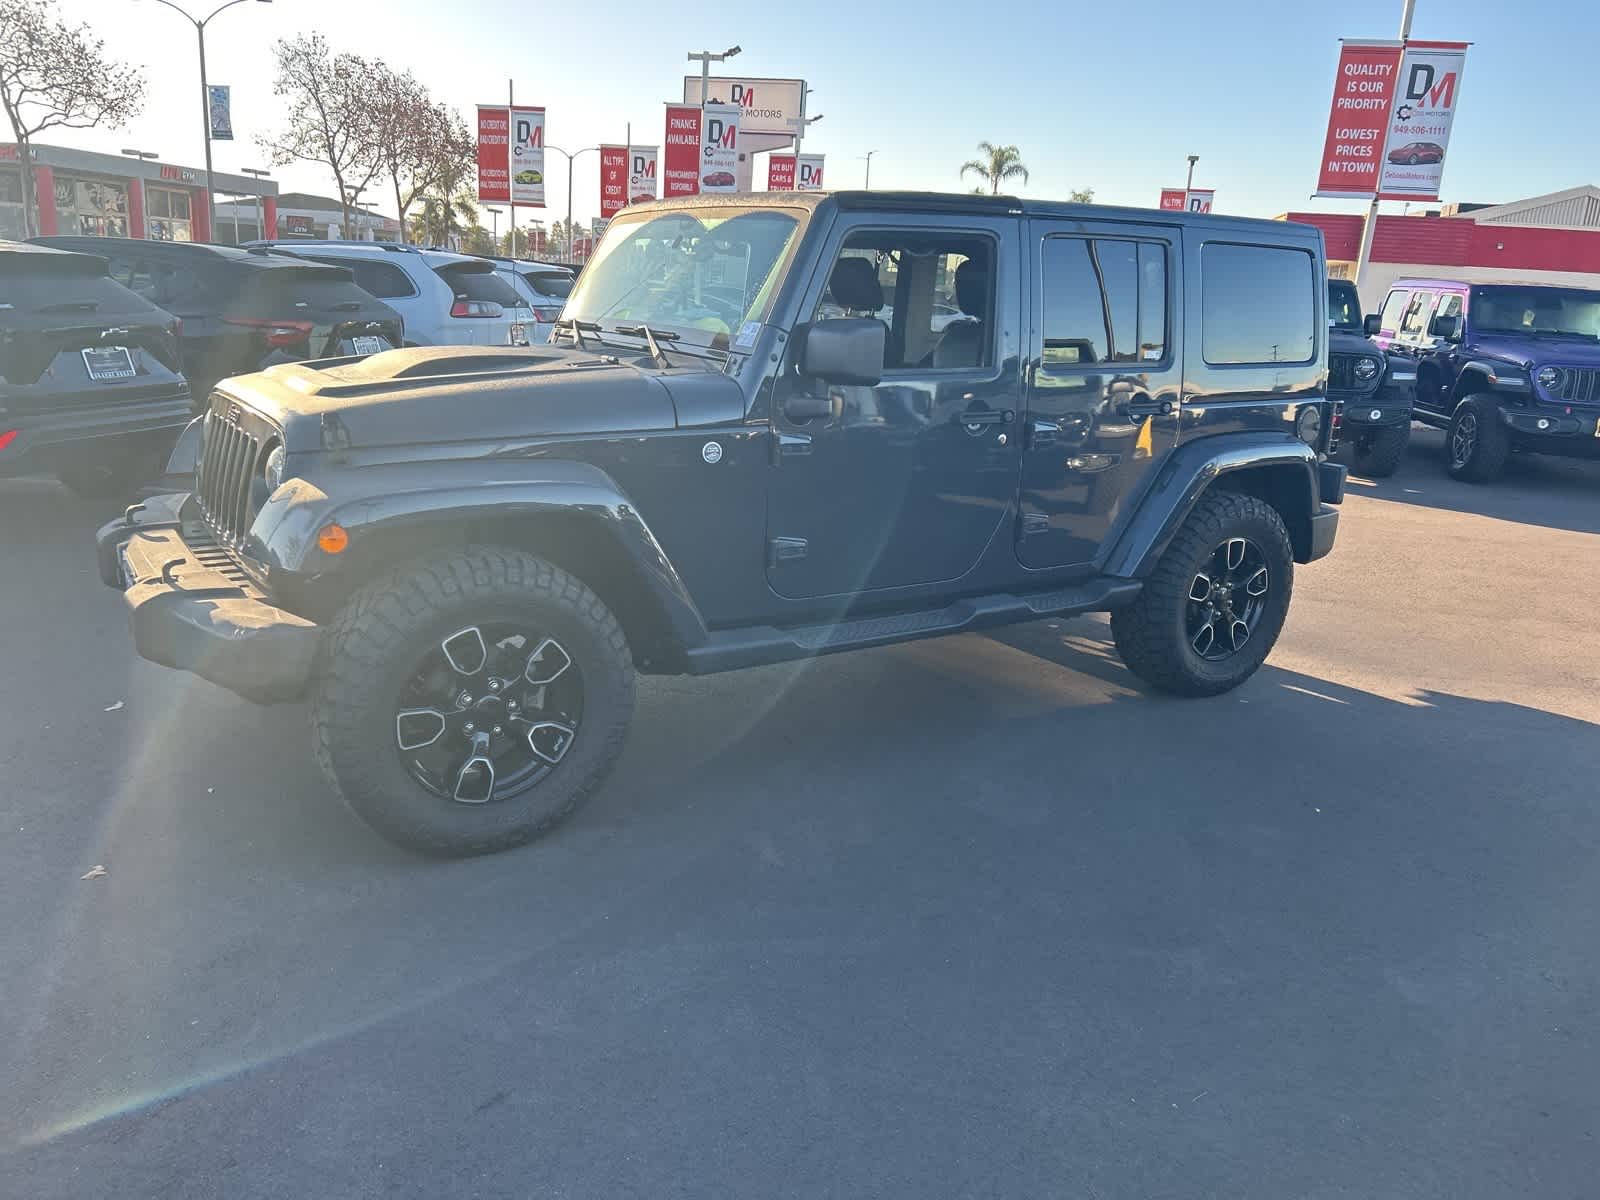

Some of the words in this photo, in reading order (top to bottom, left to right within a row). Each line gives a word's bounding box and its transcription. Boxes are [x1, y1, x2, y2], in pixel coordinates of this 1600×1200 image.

[1344, 64, 1392, 76] QUALITY
[1347, 81, 1357, 92] IS
[1359, 81, 1384, 93] OUR
[1405, 63, 1457, 109] DM
[731, 84, 754, 108] DM
[1337, 98, 1388, 110] PRIORITY
[745, 109, 782, 119] MOTORS
[670, 119, 697, 130] FINANCE
[517, 119, 542, 149] DM
[666, 133, 700, 145] AVAILABLE
[708, 119, 737, 150] DM
[1335, 128, 1380, 140] LOWEST
[1335, 145, 1373, 157] PRICES
[603, 155, 612, 166] ALL
[612, 155, 625, 167] TYPE
[633, 156, 656, 178] DM
[1328, 161, 1340, 172] IN
[1342, 162, 1376, 173] TOWN
[771, 163, 781, 172] WE
[781, 164, 794, 172] BUY
[609, 170, 617, 180] OF
[771, 174, 786, 183] CARS
[800, 164, 822, 186] DM
[605, 185, 622, 195] CREDIT
[602, 199, 625, 209] WELCOME
